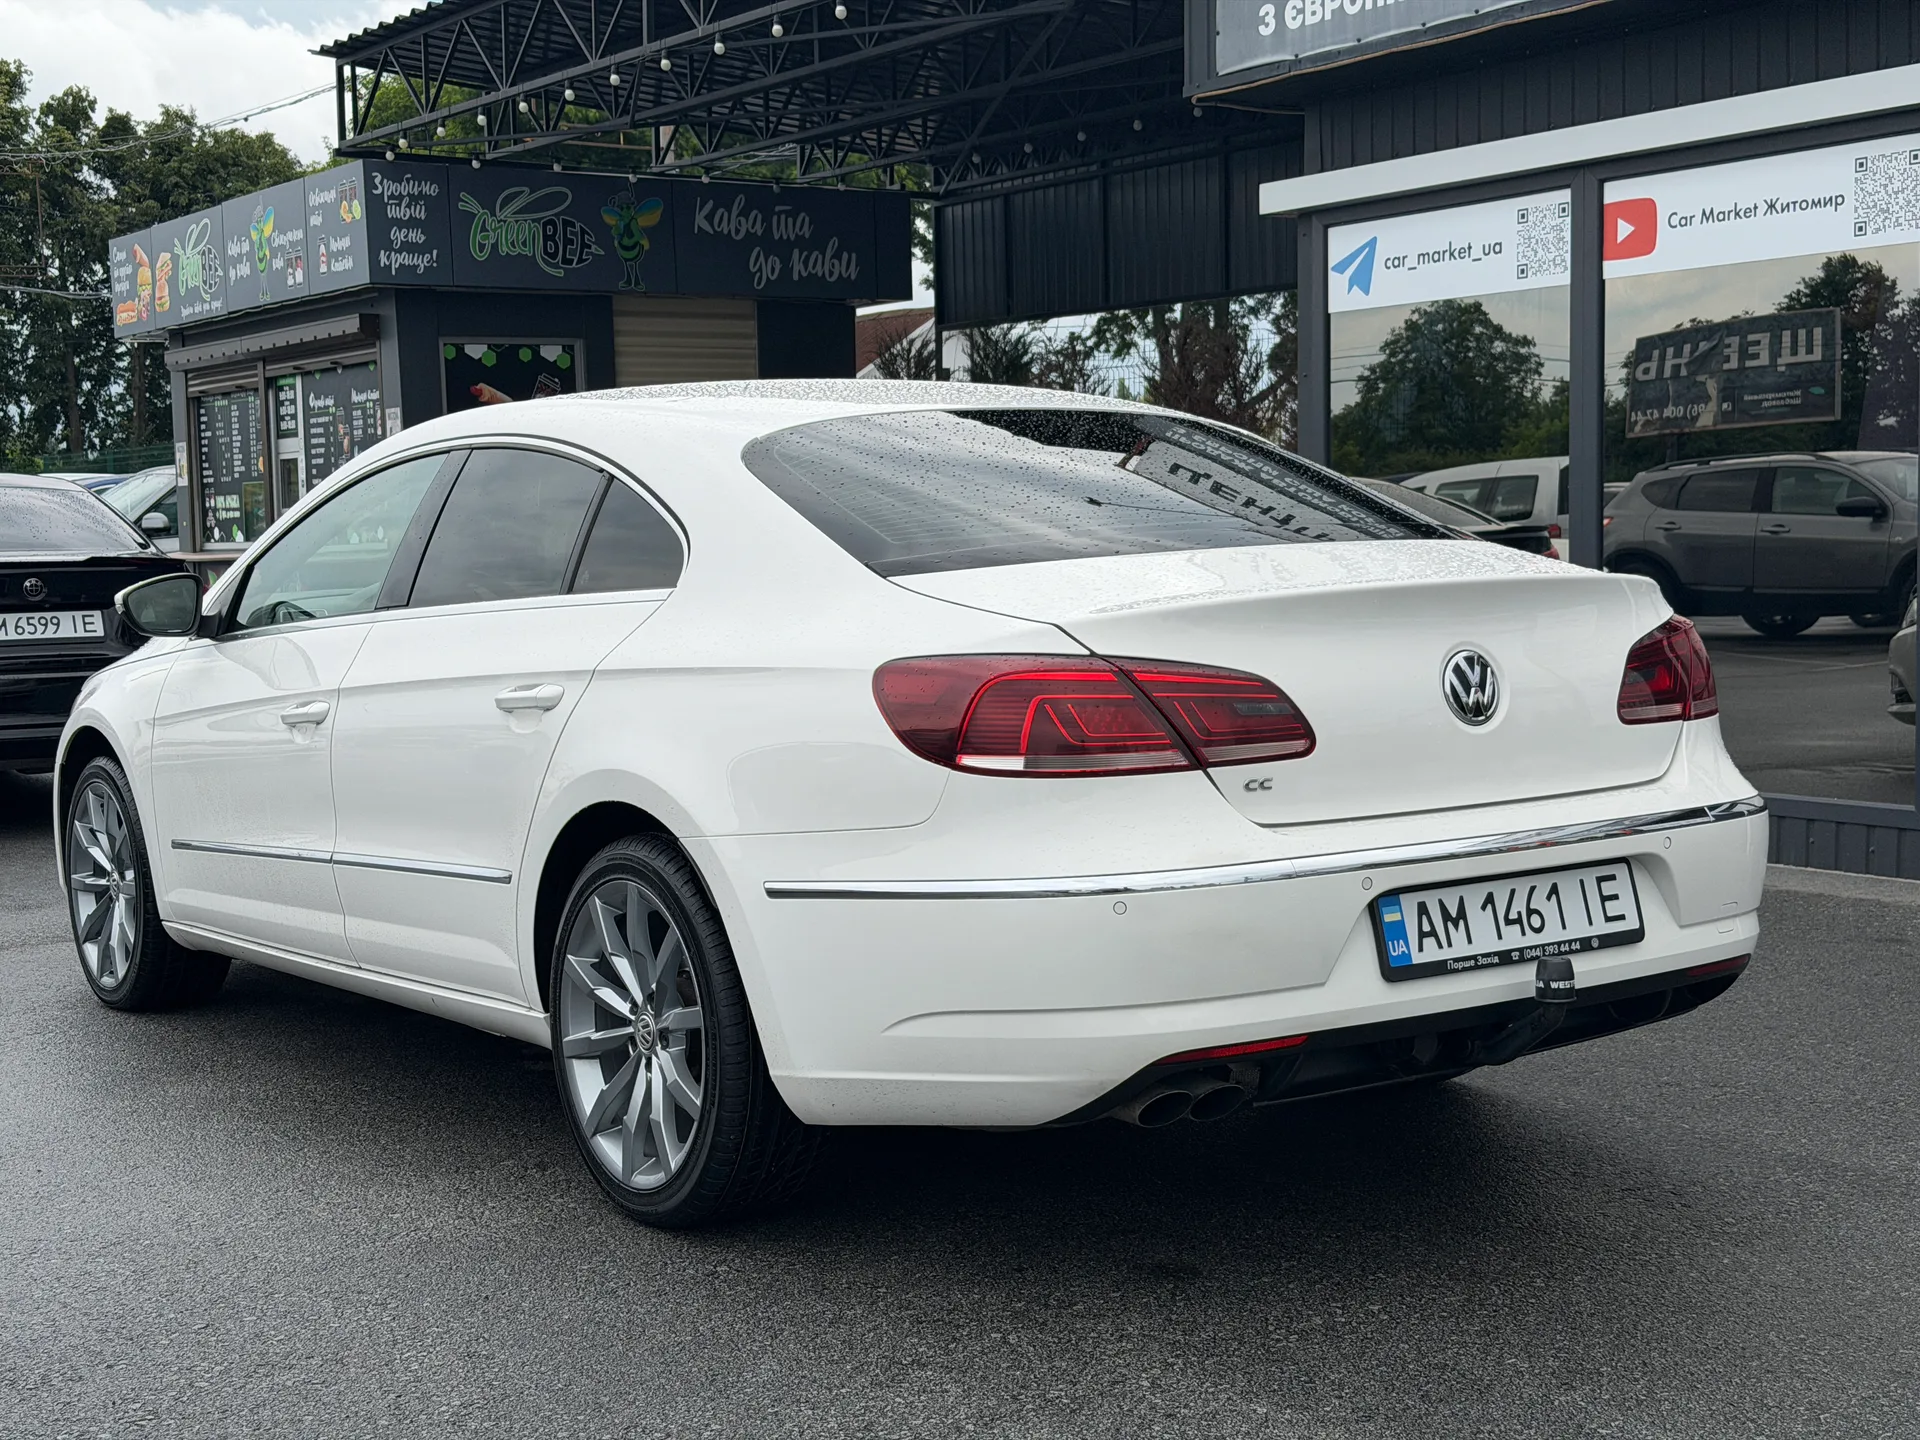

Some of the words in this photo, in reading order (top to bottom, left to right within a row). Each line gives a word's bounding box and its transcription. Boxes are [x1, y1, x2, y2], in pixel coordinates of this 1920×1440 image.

[1258, 3, 1276, 36] З
[372, 172, 439, 203] Зробимо
[387, 196, 427, 221] твій
[694, 193, 766, 241] Кава
[772, 205, 814, 242] та
[1668, 212, 1695, 229] Car
[1700, 202, 1758, 225] Market
[1763, 193, 1845, 217] Житомир
[390, 226, 426, 249] день
[378, 249, 438, 276] краще!
[749, 246, 782, 290] до
[789, 236, 860, 282] кави
[1384, 241, 1503, 271] car_market_ua
[14, 615, 61, 636] 6599
[71, 613, 97, 634] IE
[1242, 776, 1273, 792] CC
[1417, 895, 1473, 953] AM
[1480, 881, 1568, 941] 1461
[1578, 873, 1627, 927] IE
[1388, 939, 1409, 957] UA
[1447, 959, 1475, 970] Порше
[1476, 955, 1499, 965] Захід
[1523, 948, 1543, 960] (044)
[1544, 945, 1558, 956] 393
[1559, 943, 1570, 953] 44
[1570, 940, 1581, 951] 44
